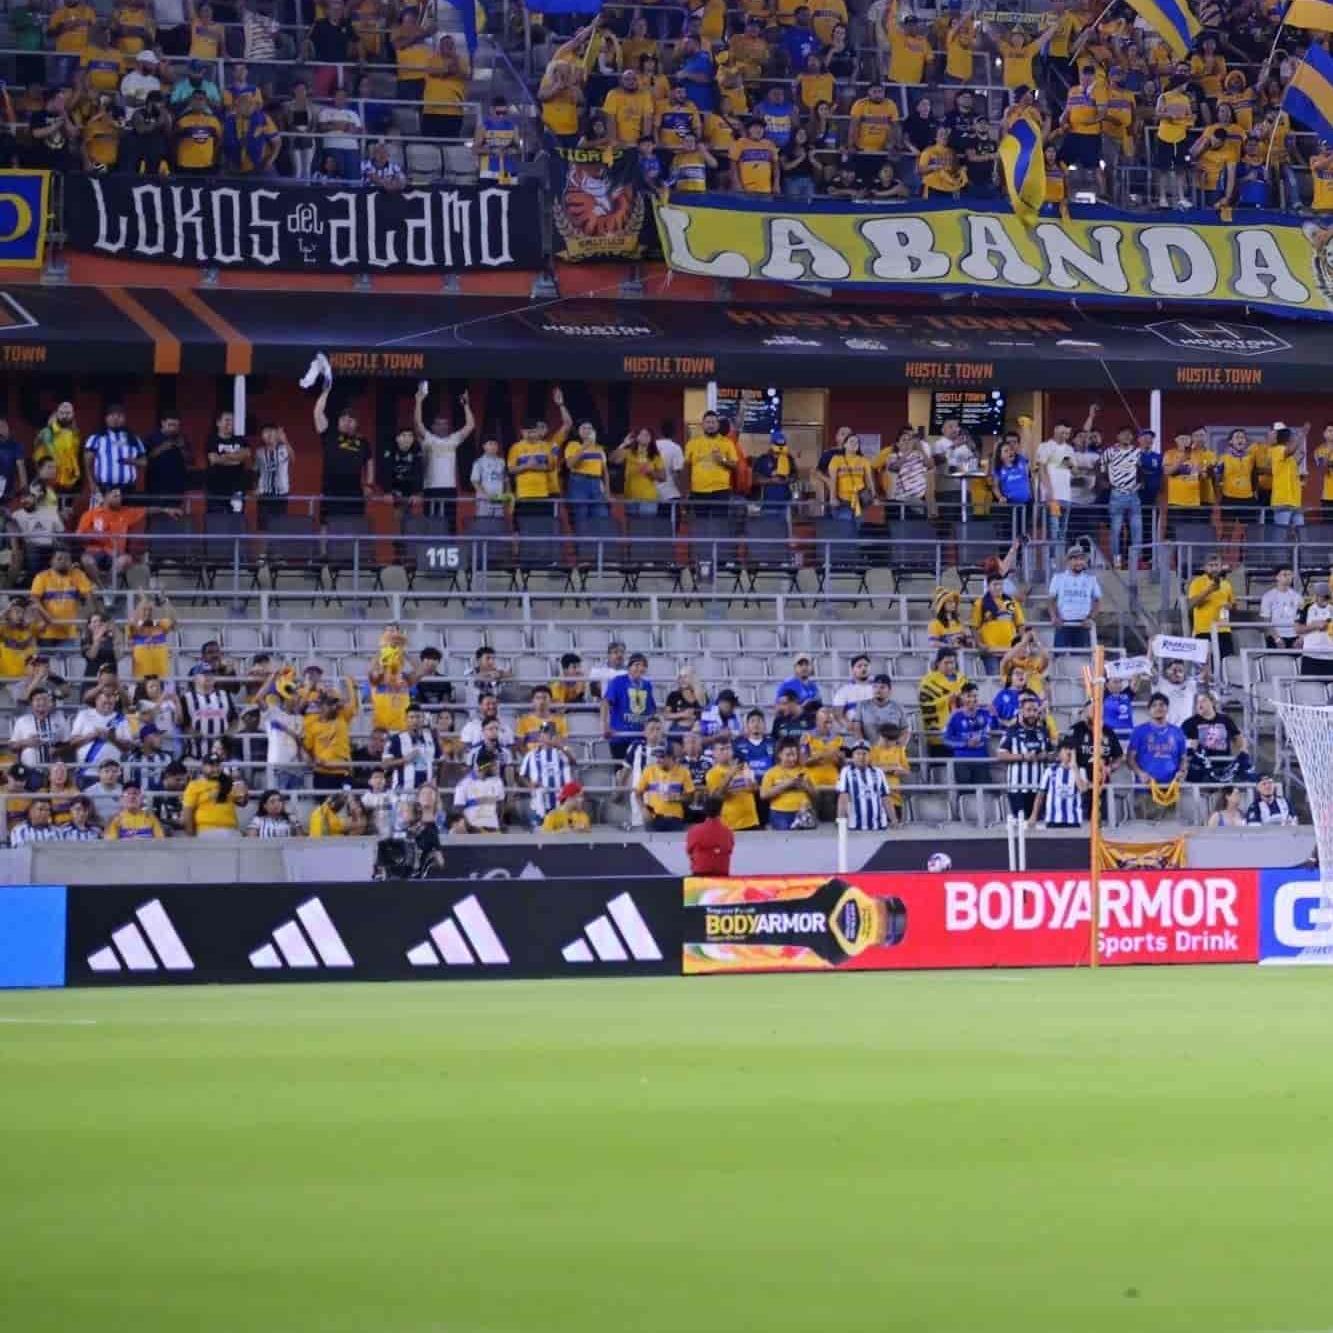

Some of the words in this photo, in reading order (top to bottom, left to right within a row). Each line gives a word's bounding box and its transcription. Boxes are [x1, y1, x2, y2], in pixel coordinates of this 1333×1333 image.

[554, 146, 624, 164] TIGR
[89, 177, 281, 265] LOKOS
[663, 204, 853, 281] LA
[857, 214, 1312, 306] BANDA
[3, 346, 47, 363] TOWN
[382, 353, 424, 370] TOWN
[623, 356, 671, 373] HUSTLE
[674, 357, 715, 374] TOWN
[905, 361, 952, 378] HUSTLE
[955, 362, 993, 379] TOWN
[1177, 367, 1222, 383] HUSTLE
[1226, 369, 1262, 384] TOWN
[426, 547, 459, 568] 115
[945, 878, 1240, 932] BODYARMOR
[705, 913, 827, 935] BODYARMOR
[1096, 931, 1167, 956] Sports
[1175, 929, 1239, 952] Drink
